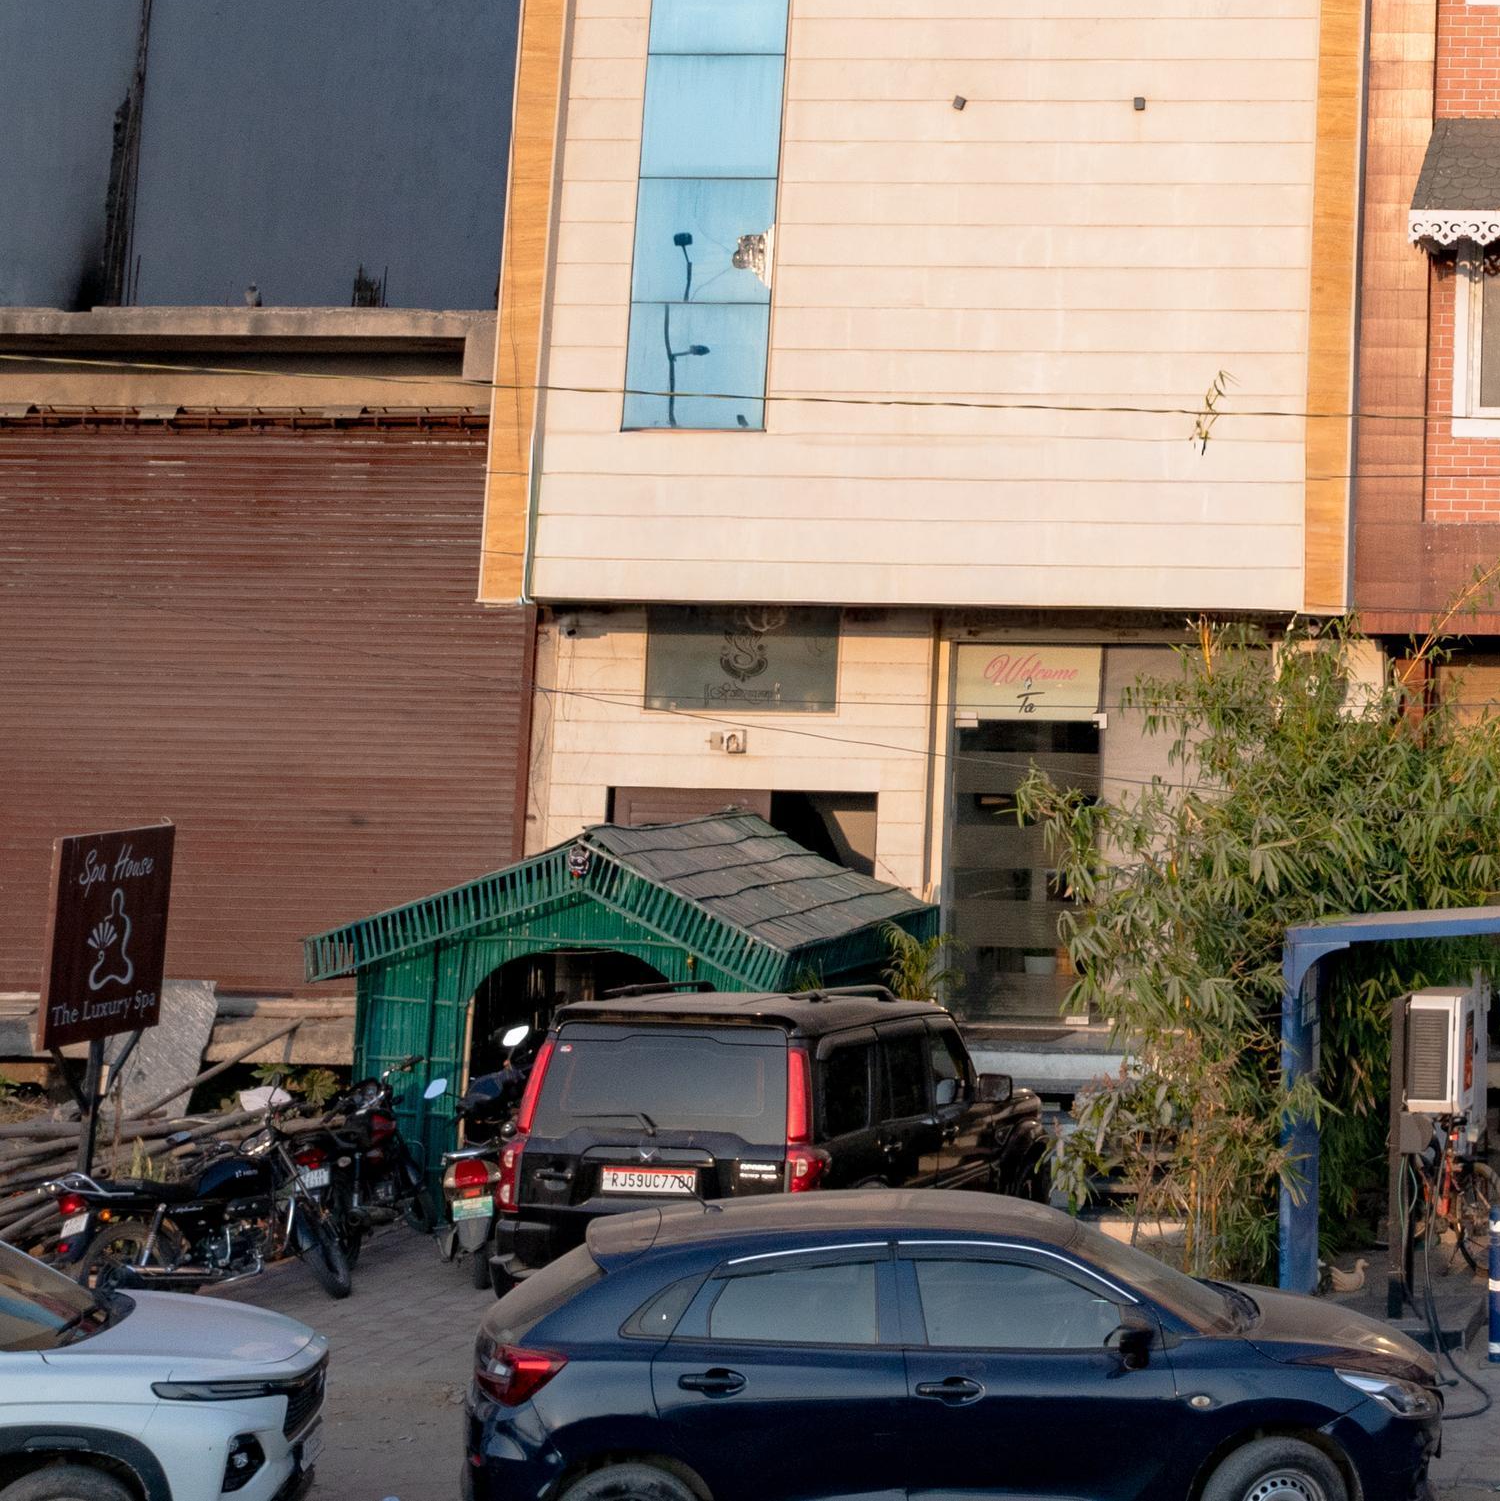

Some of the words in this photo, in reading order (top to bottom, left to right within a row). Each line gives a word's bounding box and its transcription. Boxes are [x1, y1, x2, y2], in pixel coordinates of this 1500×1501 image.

[983, 652, 1079, 685] Welcome
[79, 848, 107, 897] Spa
[111, 842, 155, 883] House
[51, 1004, 80, 1027] The
[82, 994, 133, 1022] Luxury
[134, 989, 156, 1018] Spa
